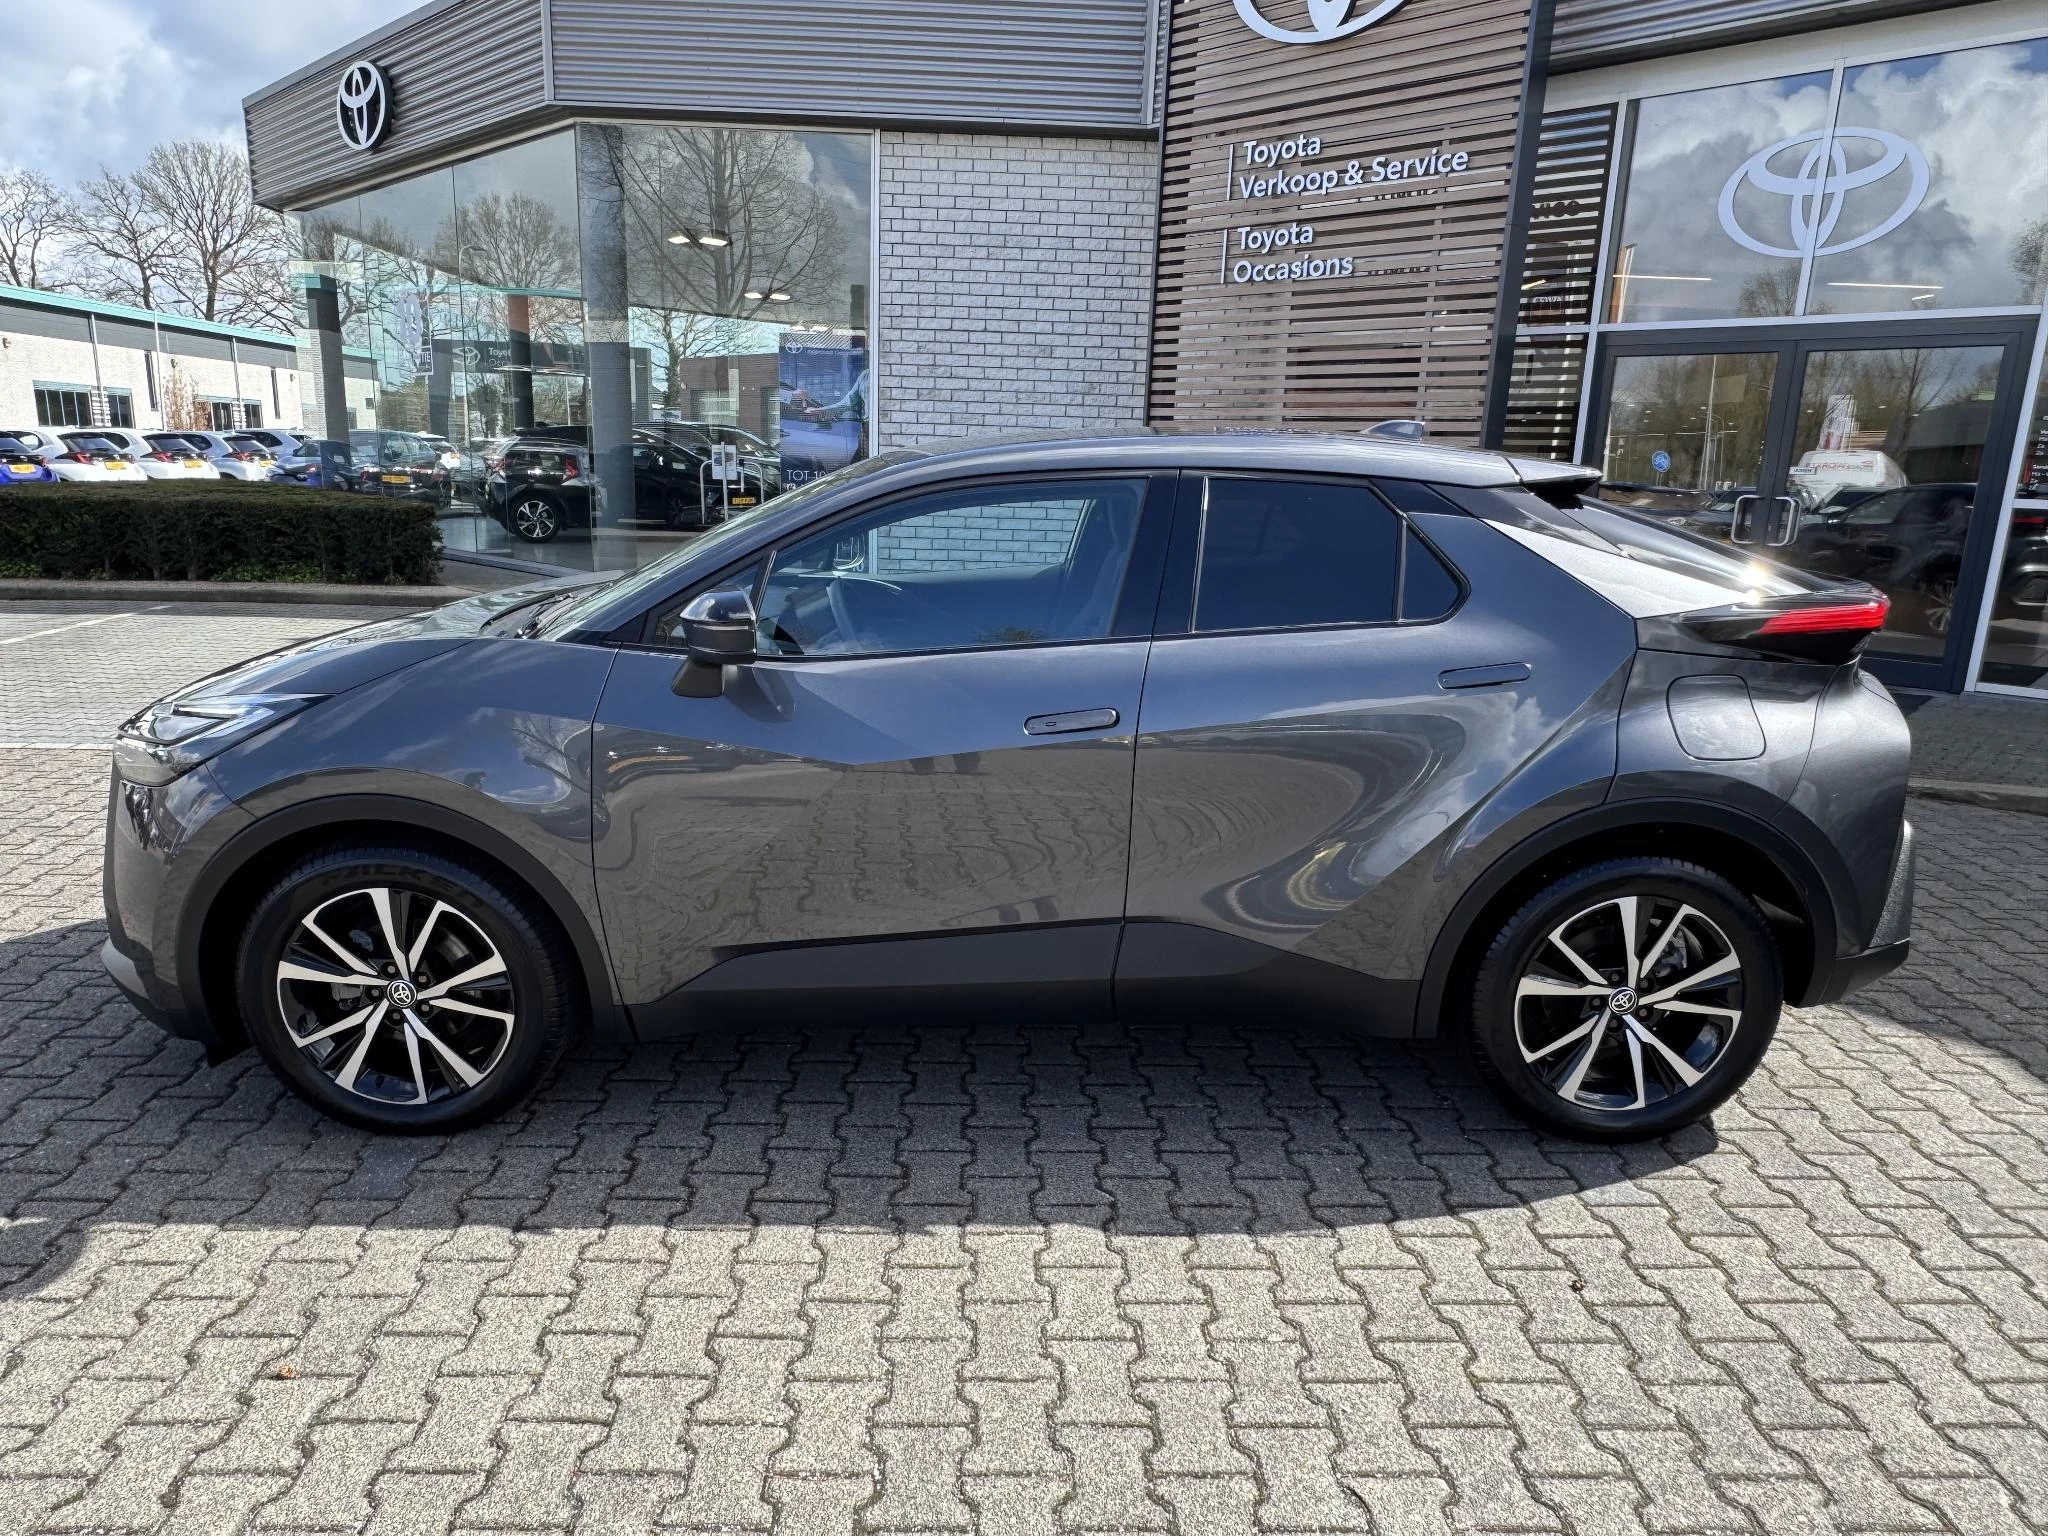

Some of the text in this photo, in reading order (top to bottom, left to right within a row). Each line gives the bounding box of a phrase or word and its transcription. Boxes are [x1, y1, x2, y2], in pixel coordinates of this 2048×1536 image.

[1243, 134, 1322, 168] Toyota
[1239, 147, 1469, 199] Verkoop & Service
[1236, 222, 1314, 253] Toyota
[1233, 253, 1354, 284] Occasions
[786, 469, 810, 481] TOT
